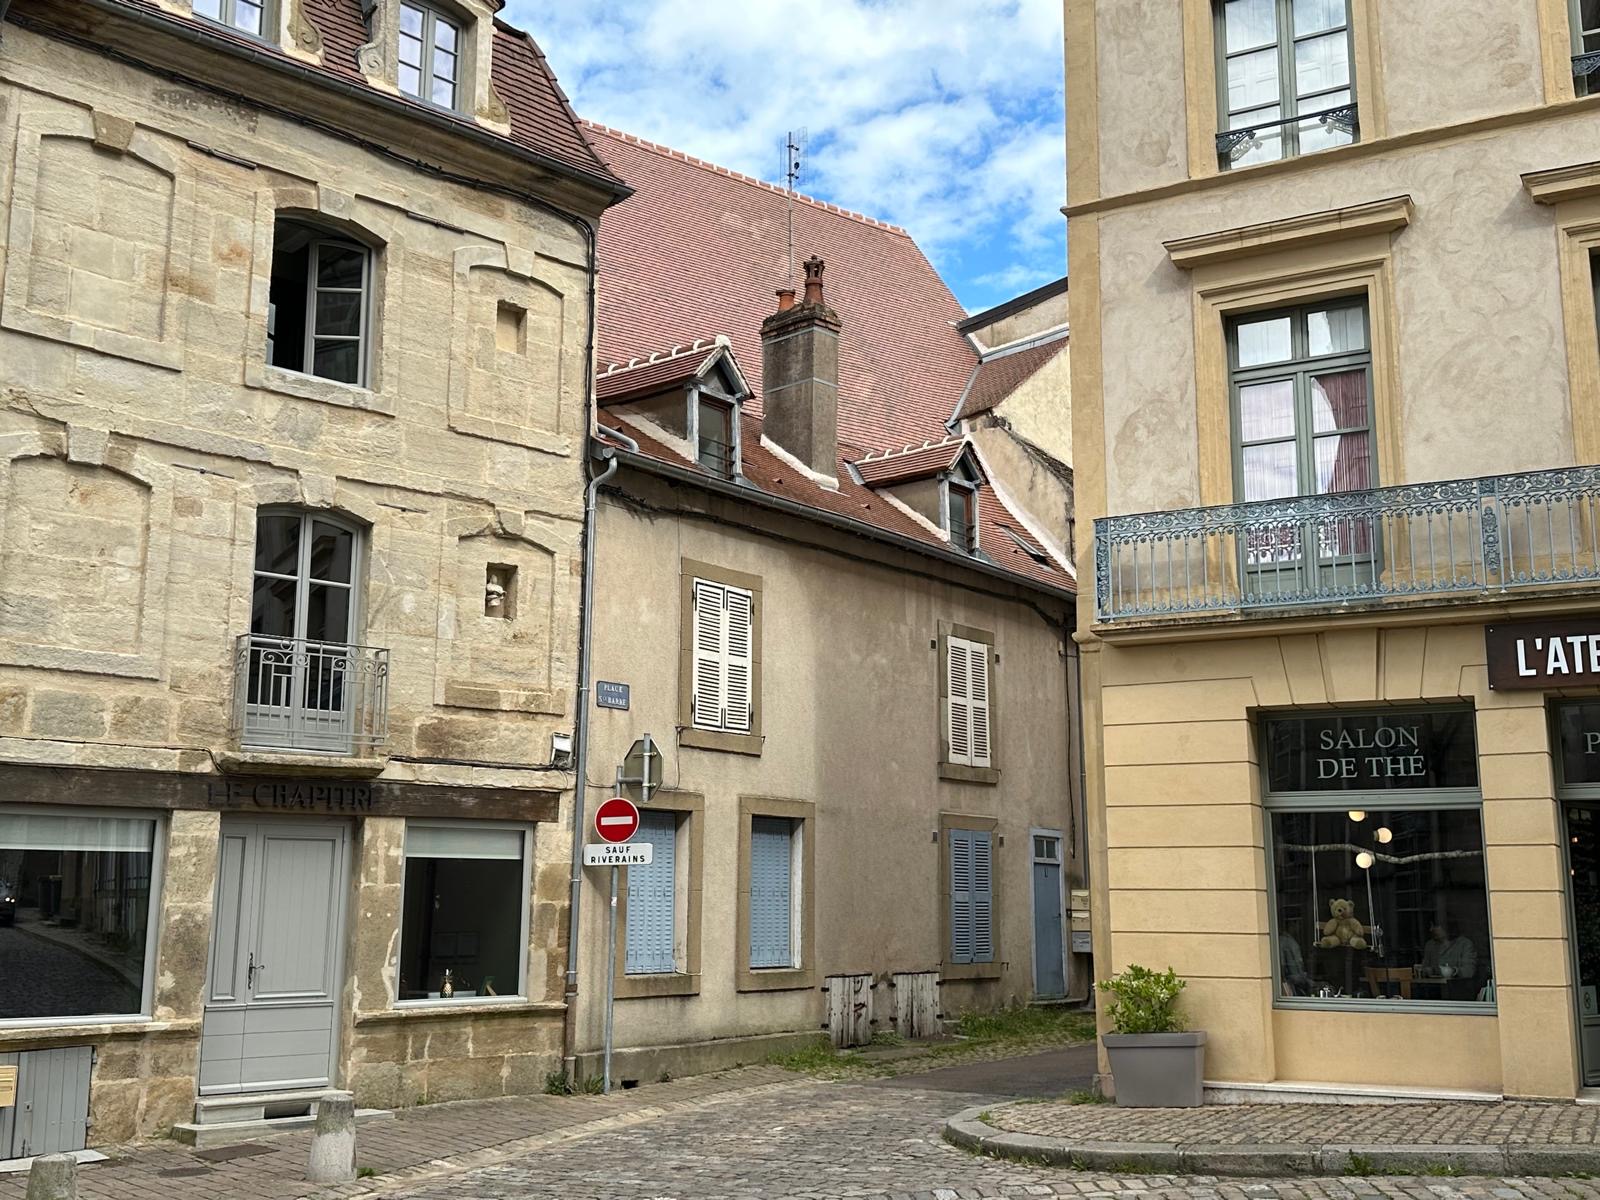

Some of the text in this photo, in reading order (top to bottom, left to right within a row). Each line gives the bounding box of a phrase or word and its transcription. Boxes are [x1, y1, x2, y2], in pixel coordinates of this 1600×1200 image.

[603, 684, 624, 693] PLACE
[1320, 726, 1420, 750] SALON
[1316, 748, 1427, 779] DE THÉ
[207, 780, 243, 808] LE
[605, 846, 631, 854] SAUF
[590, 855, 646, 864] RIVERAINS
